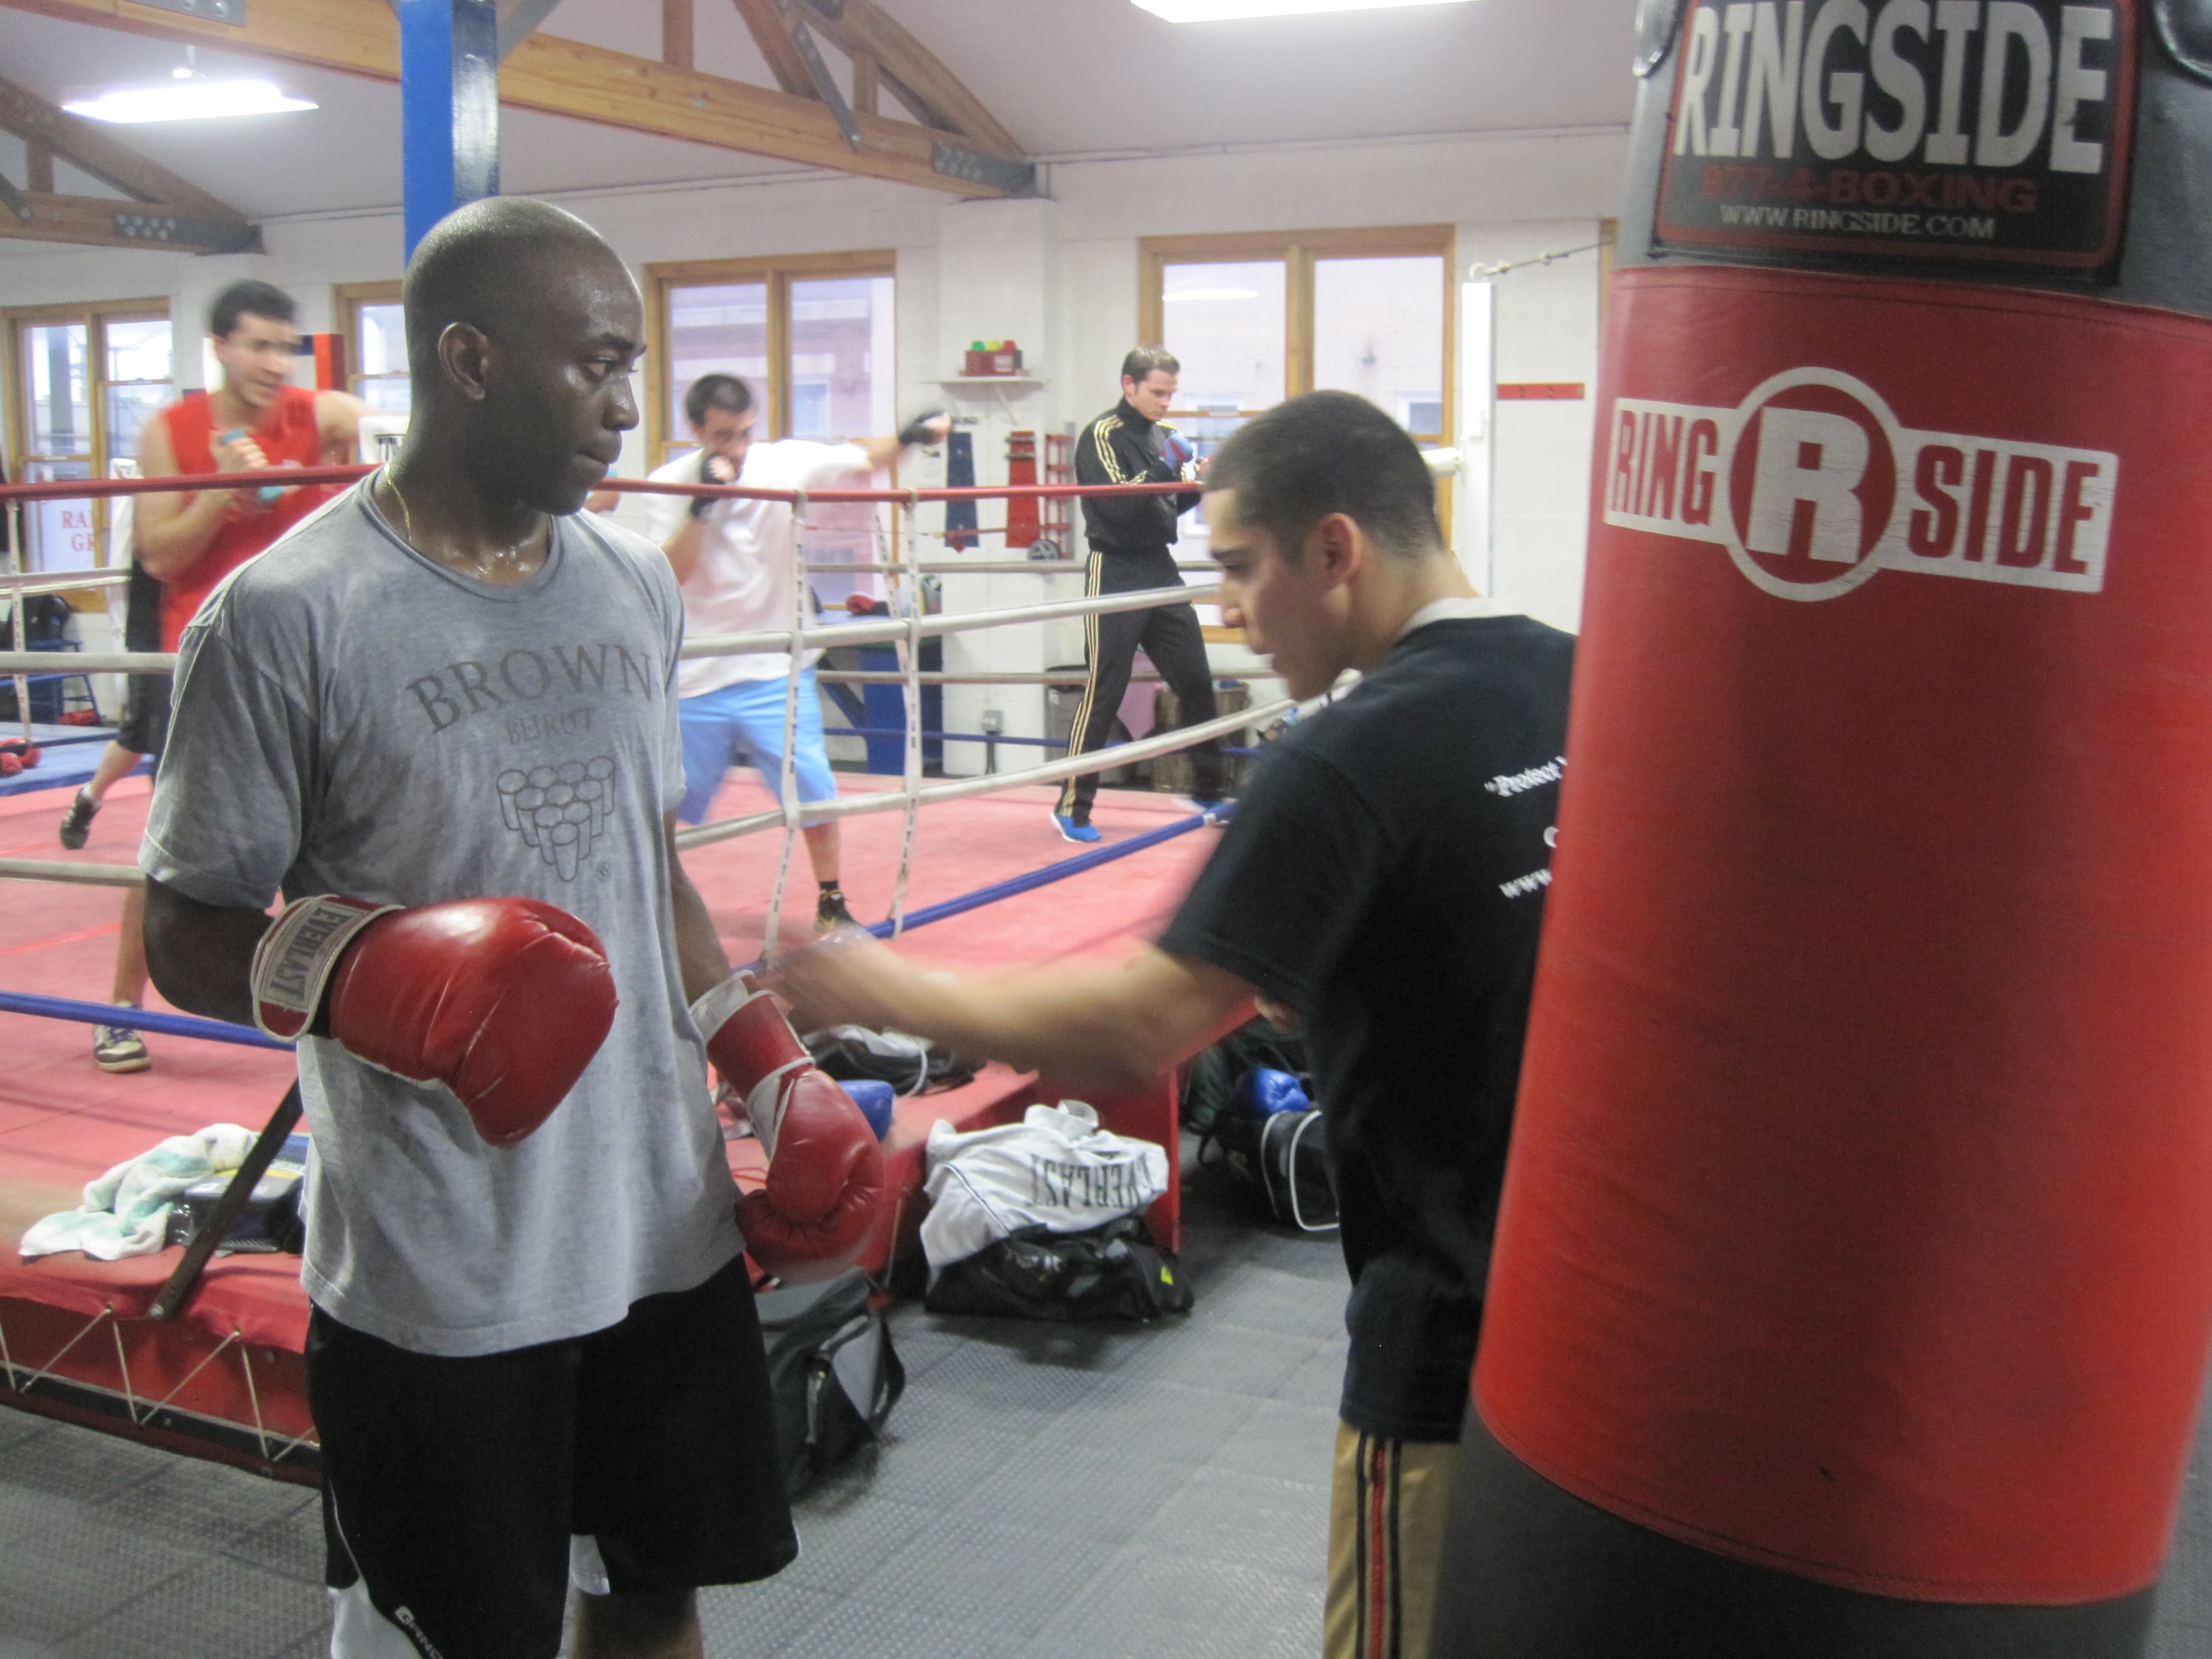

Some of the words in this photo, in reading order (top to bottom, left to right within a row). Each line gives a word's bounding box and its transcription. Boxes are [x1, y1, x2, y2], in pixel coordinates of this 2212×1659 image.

[1672, 0, 2114, 174] RINGSIDE
[1613, 409, 1719, 526] RING
[1906, 442, 2101, 576] SIDE
[406, 643, 653, 735] BROWN
